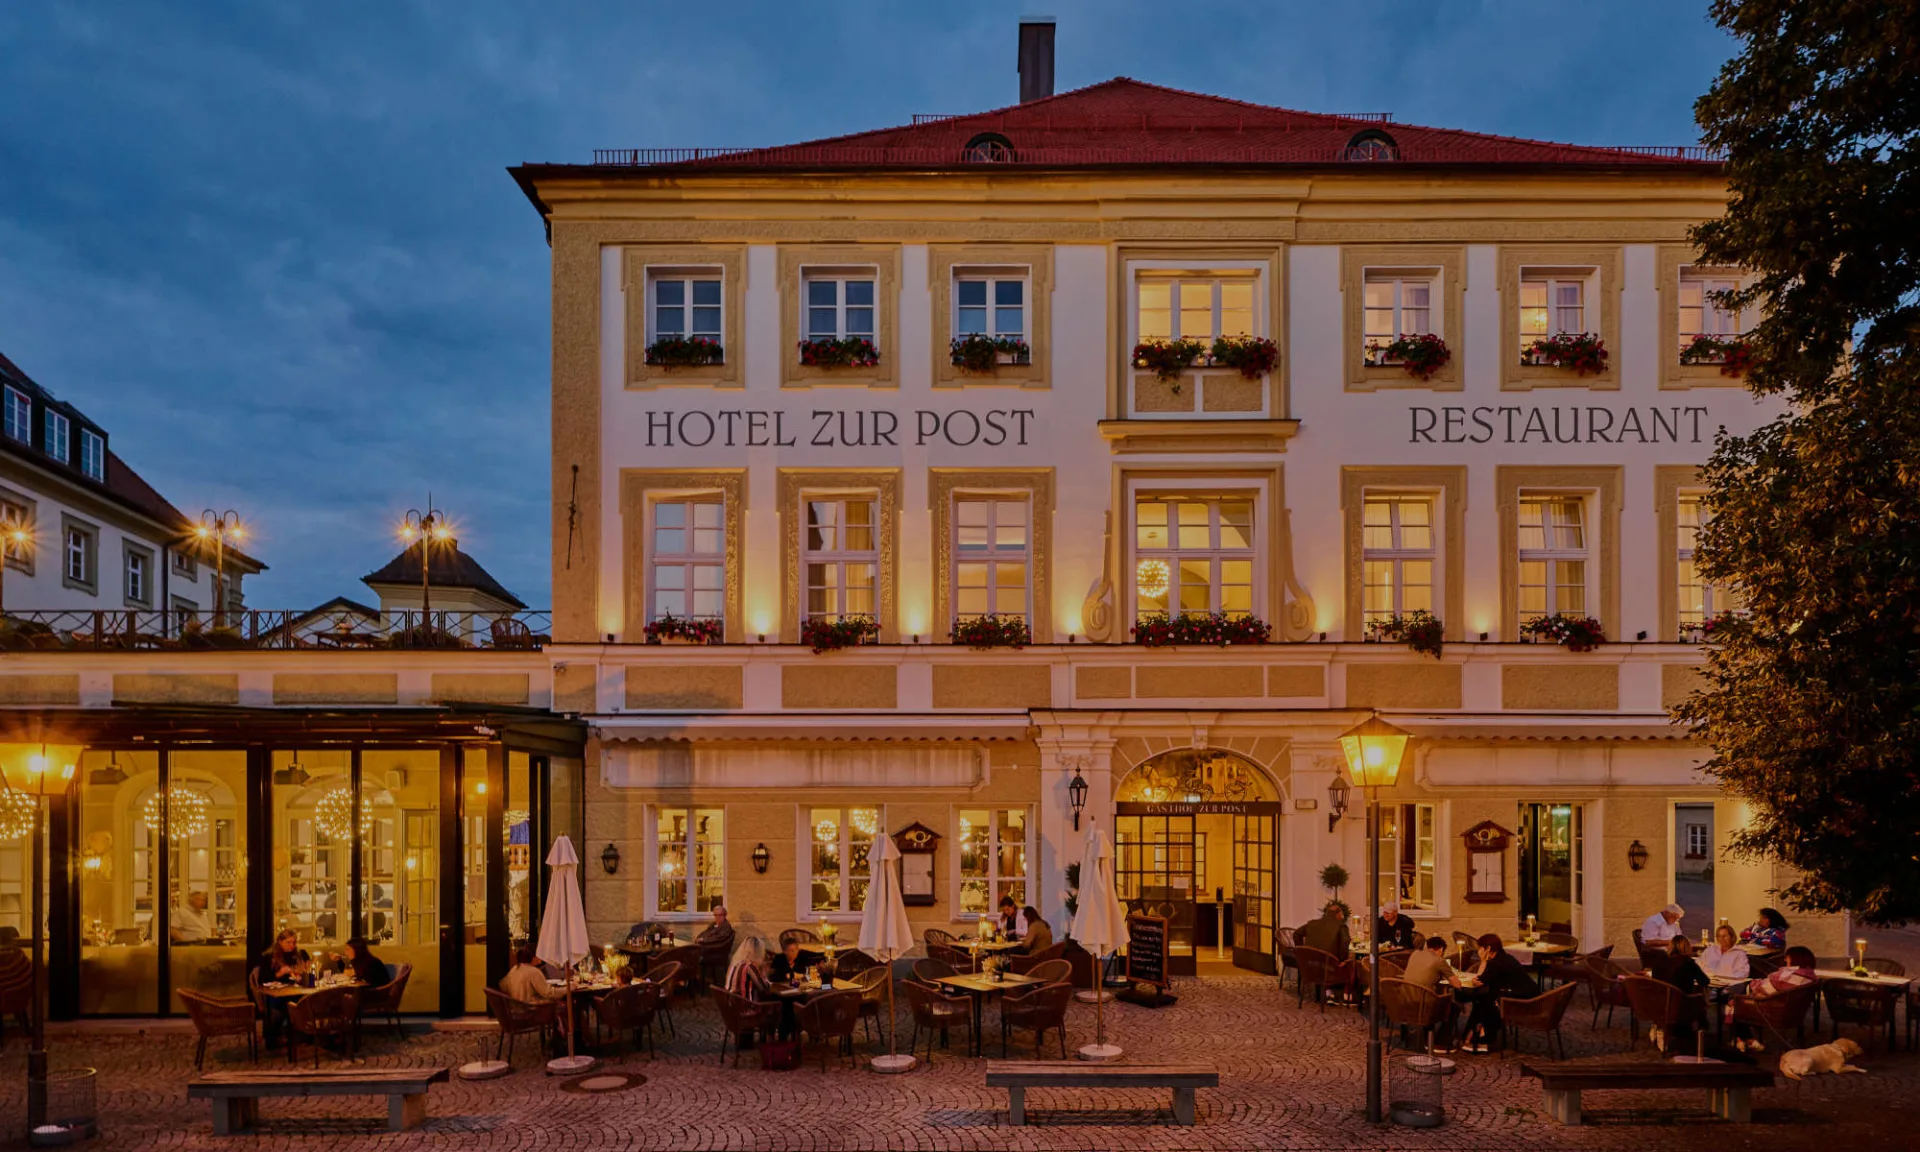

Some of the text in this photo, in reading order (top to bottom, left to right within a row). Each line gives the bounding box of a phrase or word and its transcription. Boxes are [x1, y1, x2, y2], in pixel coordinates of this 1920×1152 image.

[645, 409, 1035, 447] HOTEL ZUR POST
[1408, 406, 1709, 444] RESTAURANT
[1199, 804, 1219, 813] ZUR
[1221, 804, 1248, 813] POST
